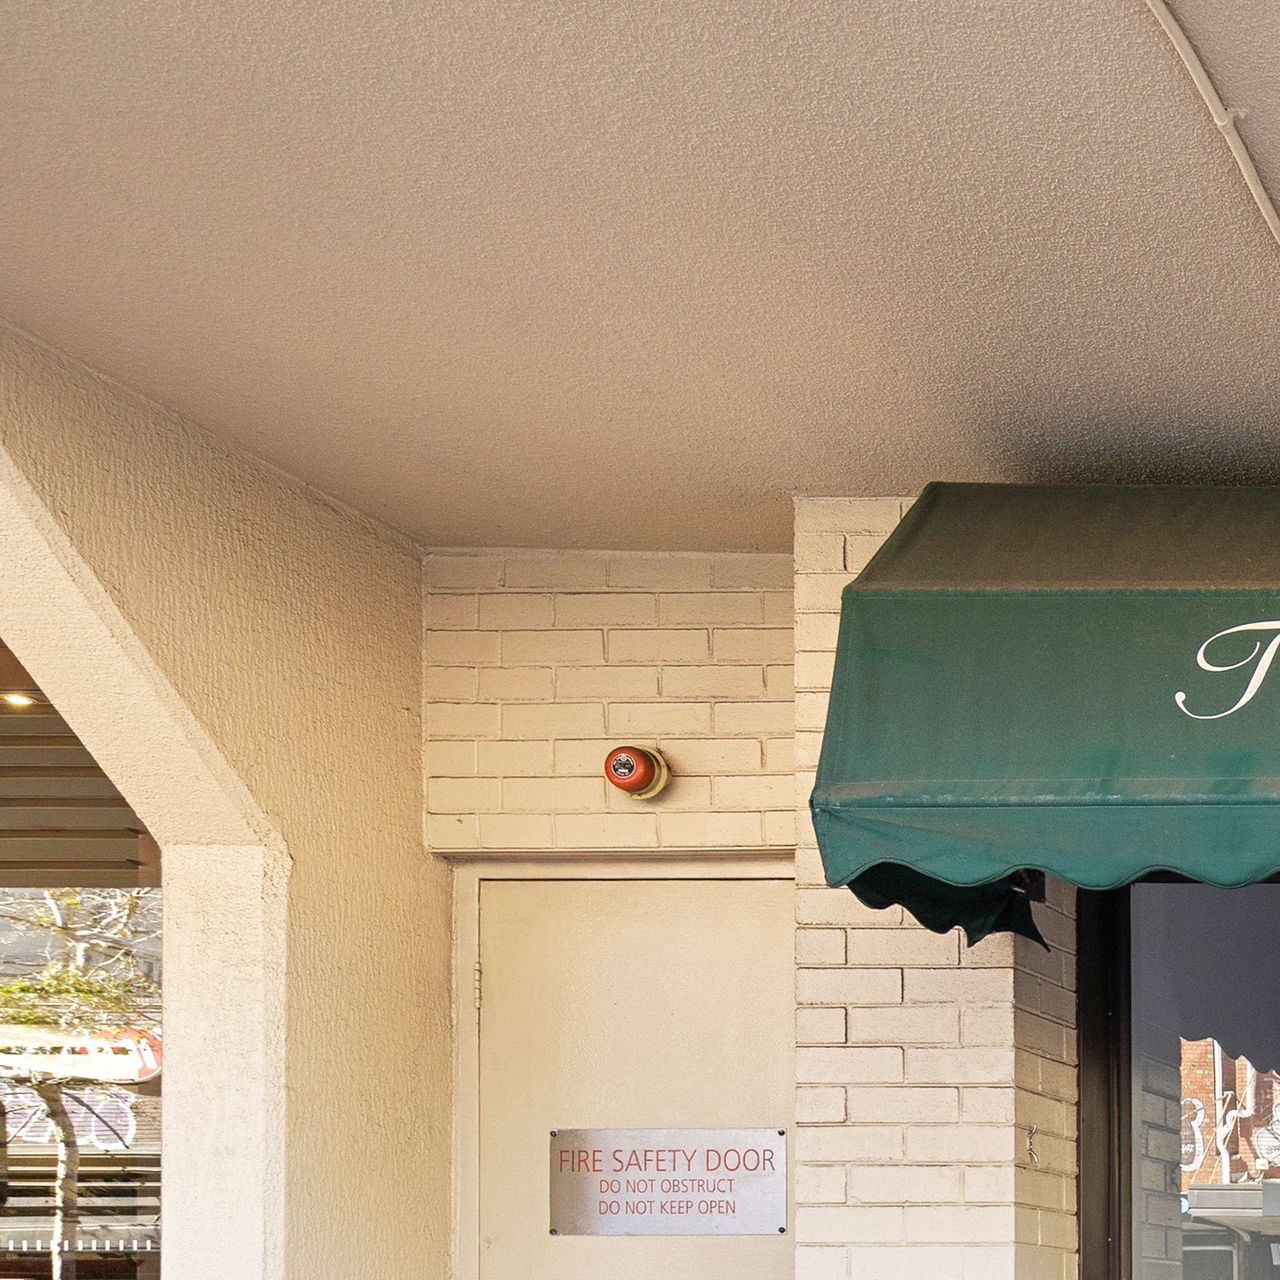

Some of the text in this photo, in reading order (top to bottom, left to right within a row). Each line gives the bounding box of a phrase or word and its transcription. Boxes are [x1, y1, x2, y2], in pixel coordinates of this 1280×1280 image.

[559, 1148, 775, 1173] FIRE SAFETY DOOR
[599, 1178, 735, 1194] DO NOT OBSTRUCT
[599, 1200, 736, 1215] DO NOT KEEP OPEN
